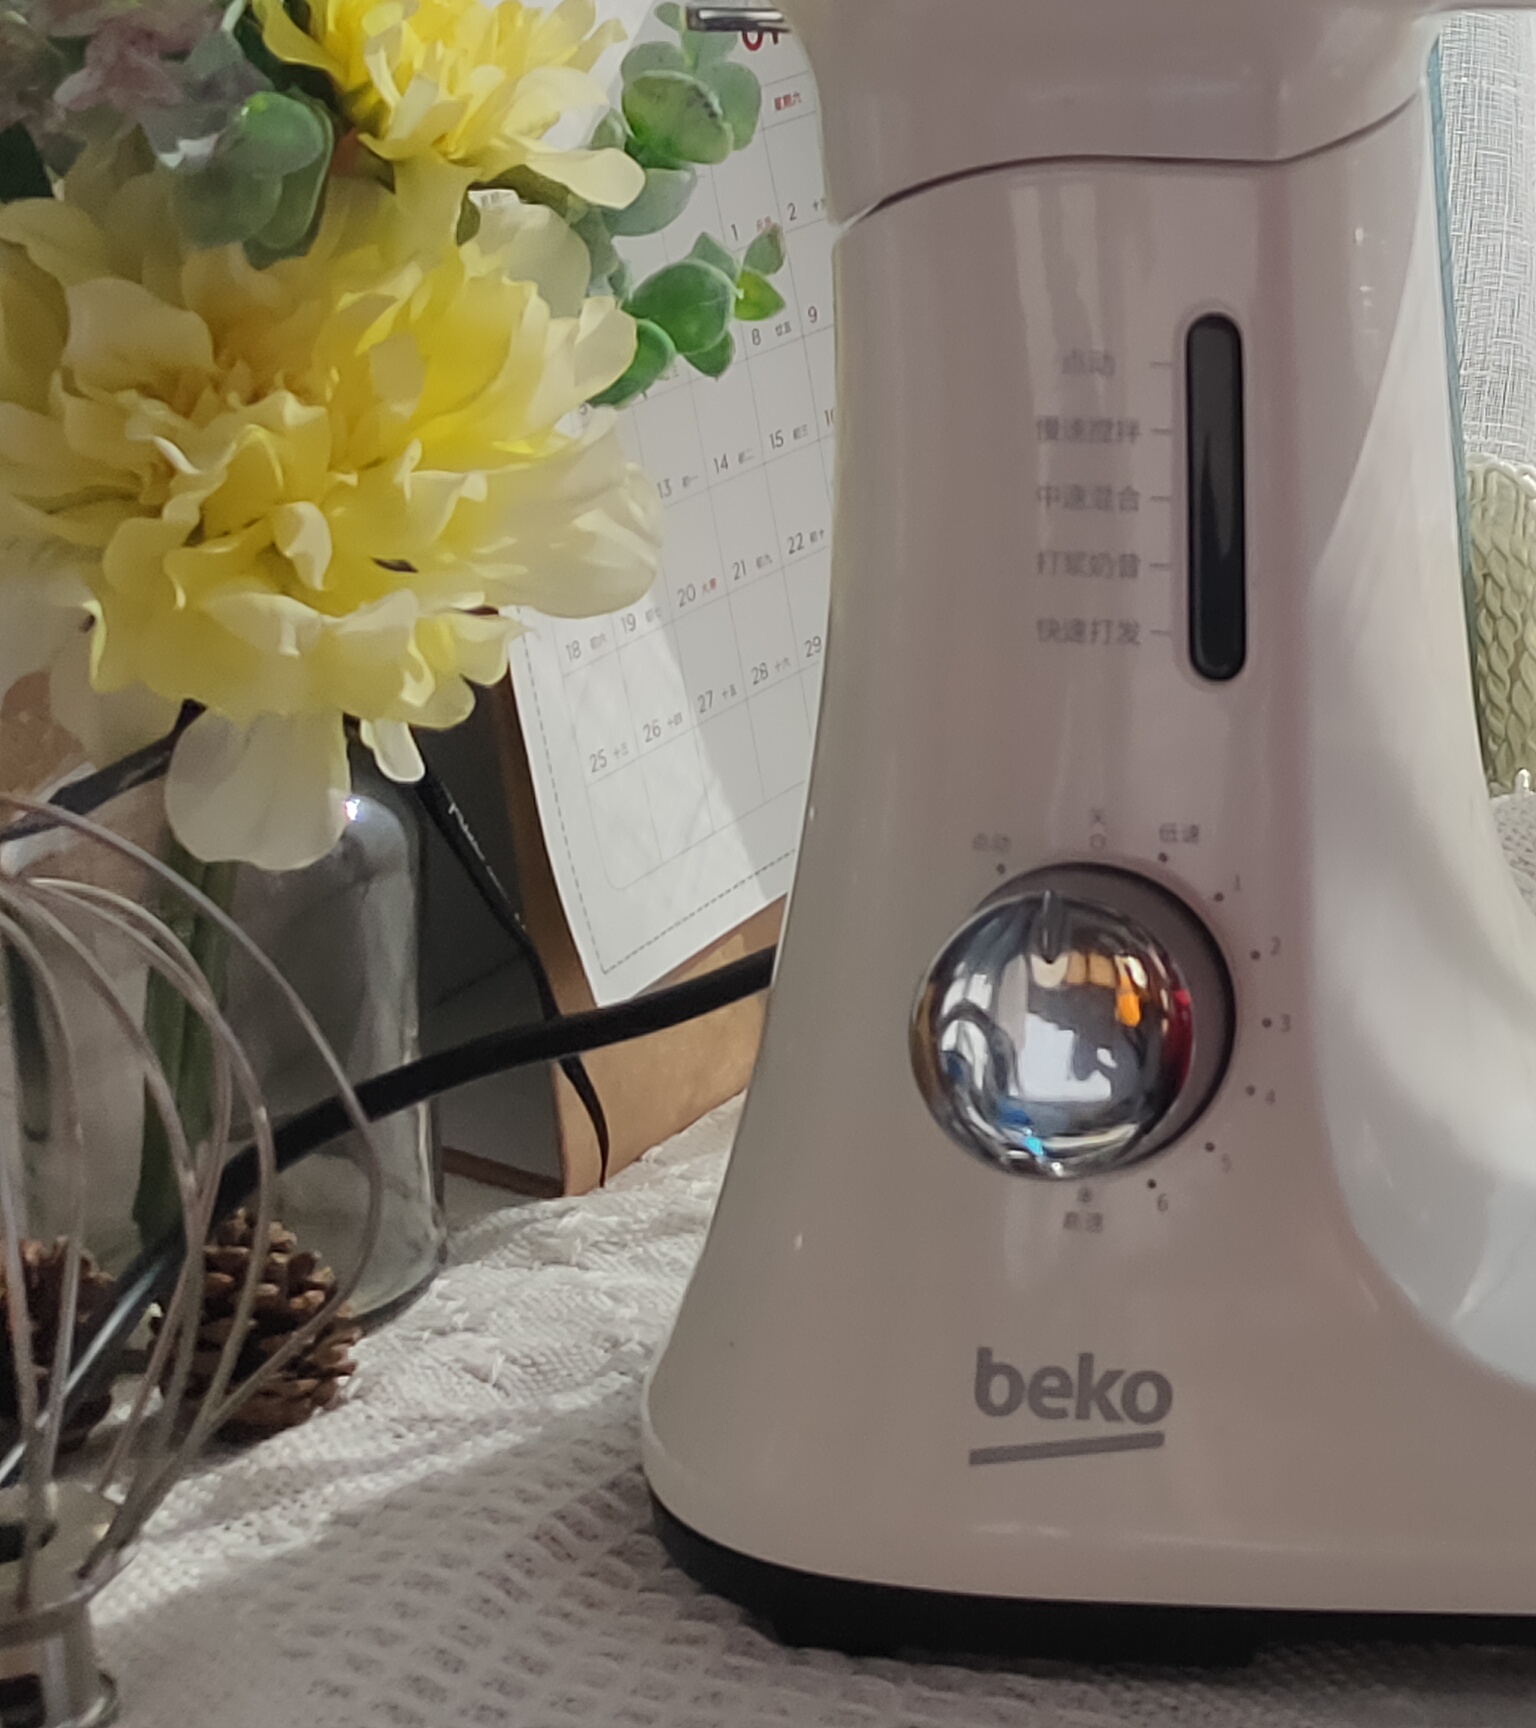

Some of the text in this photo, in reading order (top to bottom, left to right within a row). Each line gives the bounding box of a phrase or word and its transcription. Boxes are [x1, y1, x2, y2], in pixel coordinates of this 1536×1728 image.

[787, 202, 797, 221] 2
[731, 223, 739, 241] 1
[807, 305, 818, 323] 9
[751, 328, 762, 346] 8
[769, 429, 785, 450] 15
[713, 453, 730, 474] 14
[657, 478, 673, 500] 13
[787, 532, 805, 554] 22
[732, 559, 748, 581] 21
[677, 583, 697, 608] 20
[620, 613, 637, 635] 19
[565, 639, 582, 662] 18
[804, 635, 822, 658] 29
[751, 662, 769, 685] 28
[697, 690, 713, 714] 27
[642, 719, 662, 744] 26
[589, 748, 608, 773] 25
[1270, 935, 1281, 956] 2
[1280, 1013, 1292, 1033] 3
[1156, 1192, 1169, 1213] 6
[973, 1345, 1174, 1426] beko
